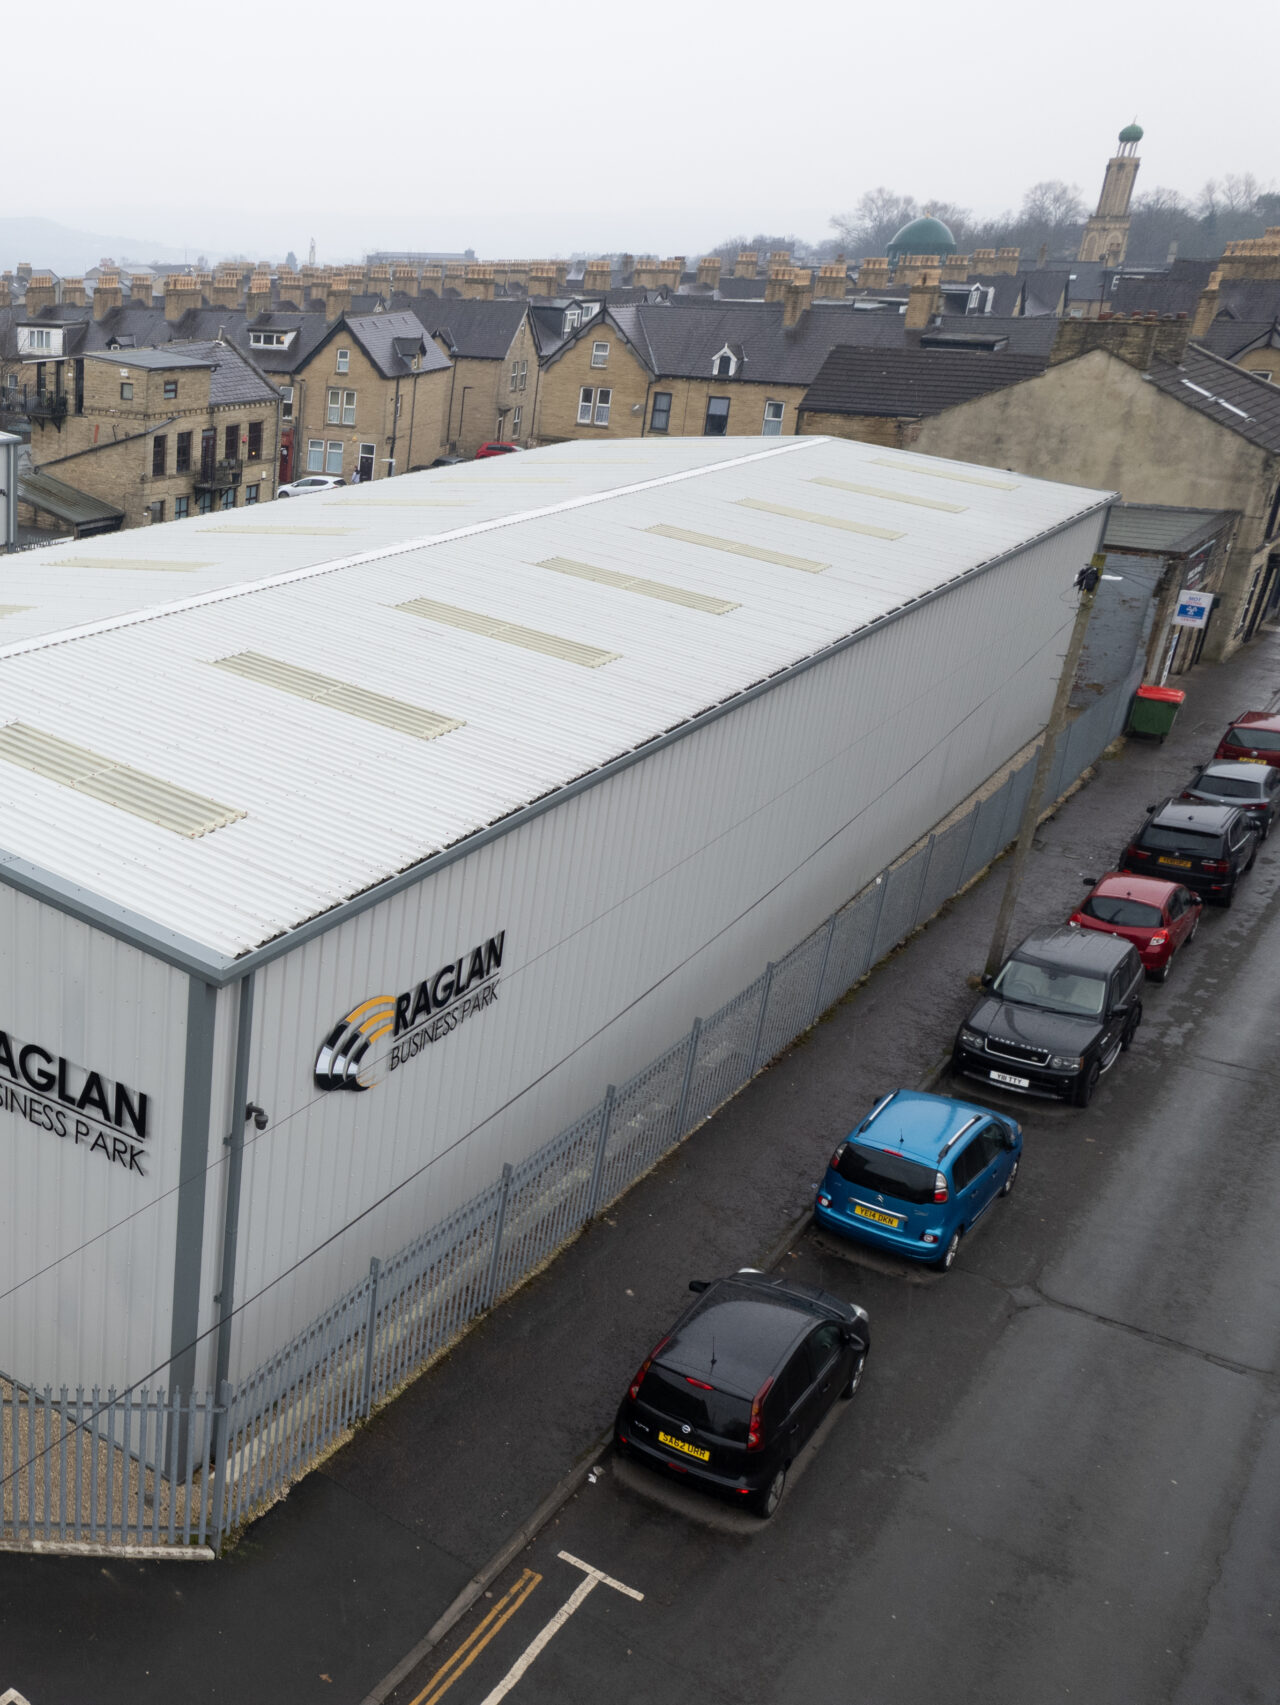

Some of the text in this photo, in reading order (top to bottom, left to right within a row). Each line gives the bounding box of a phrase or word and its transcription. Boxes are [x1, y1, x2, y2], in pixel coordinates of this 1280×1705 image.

[393, 929, 506, 1037] RAGLAN
[390, 979, 500, 1071] BUSINESS PARK
[75, 1119, 145, 1177] PARK
[860, 1207, 876, 1220] YE14
[662, 1433, 686, 1450] SA62
